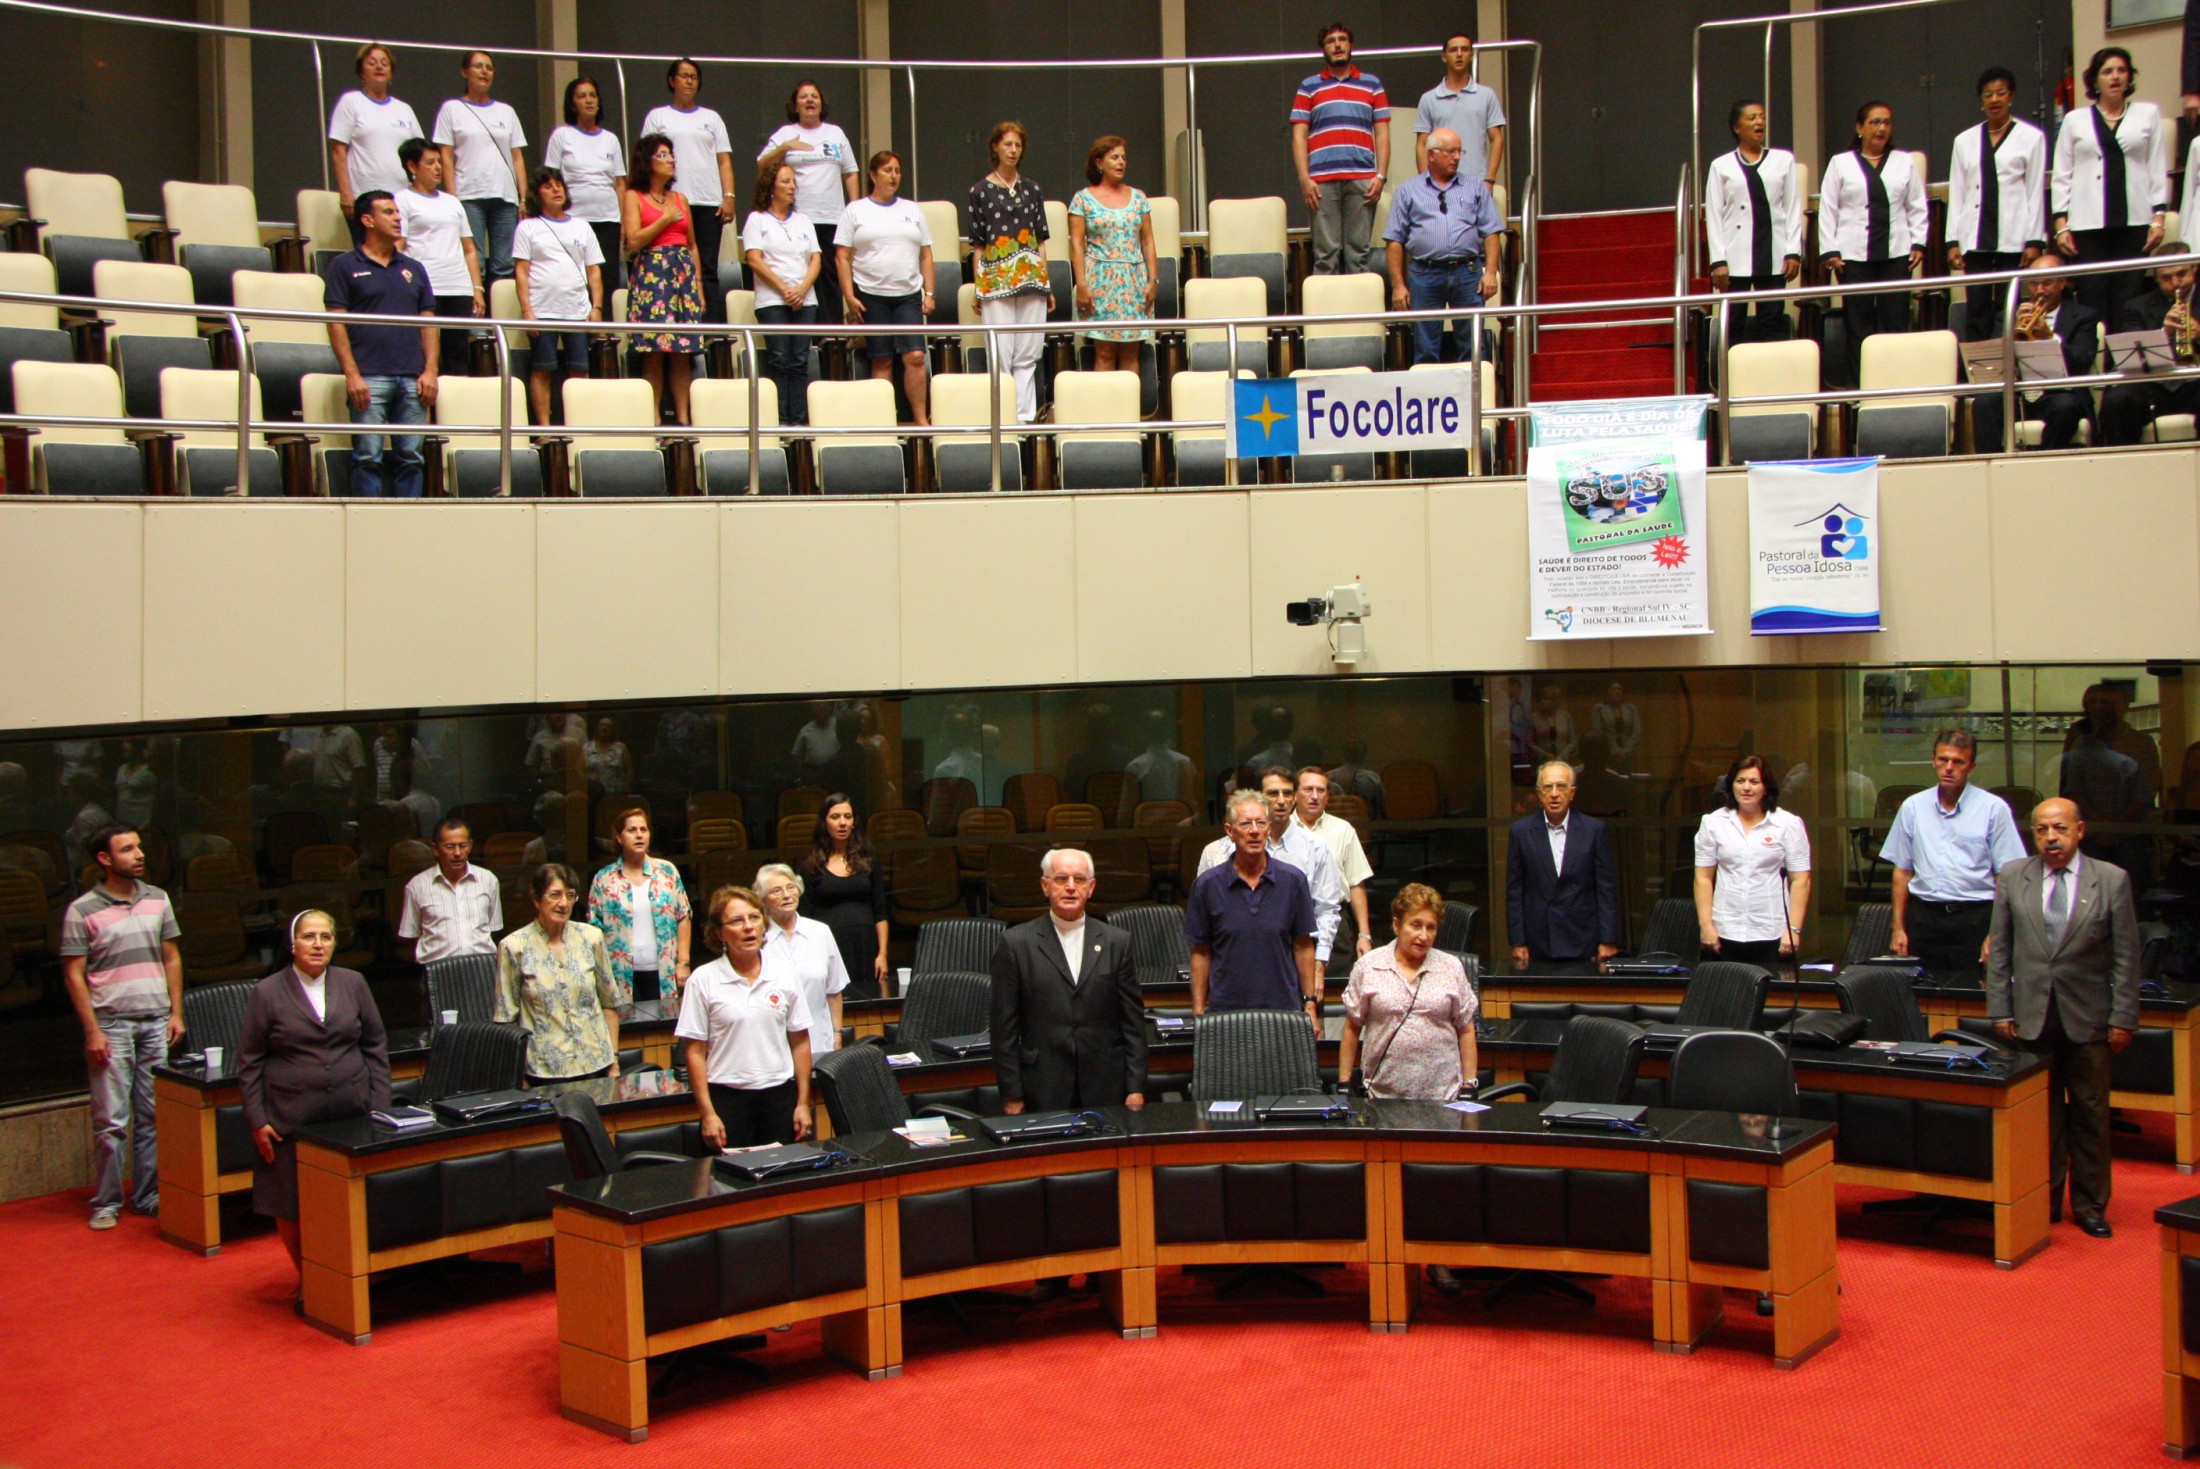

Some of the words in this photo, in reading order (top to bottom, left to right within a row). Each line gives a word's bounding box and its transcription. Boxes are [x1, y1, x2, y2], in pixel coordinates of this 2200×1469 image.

[1307, 386, 1459, 439] Focolare
[1542, 414, 1588, 425] TODO
[1593, 413, 1621, 423] DIA
[1641, 410, 1669, 421] DIA
[1674, 409, 1696, 420] DE
[1542, 427, 1584, 438] LUTA
[1589, 425, 1629, 436] PELA
[1568, 469, 1667, 507] SUS
[1576, 531, 1625, 544] PASTORAL
[1627, 528, 1640, 536] DA
[1573, 556, 1605, 564] DIREITO
[1619, 554, 1647, 562] TODOS
[1759, 549, 1805, 562] Pastoral
[1807, 551, 1819, 560] da
[1767, 562, 1811, 575] Pessoa
[1814, 560, 1852, 573] Idosa
[1613, 604, 1646, 613] Regional
[1648, 603, 1660, 611] Sul
[1679, 602, 1690, 610] SC
[1583, 616, 1622, 625] DIOCESE
[1638, 614, 1689, 623] BLUMENAU
